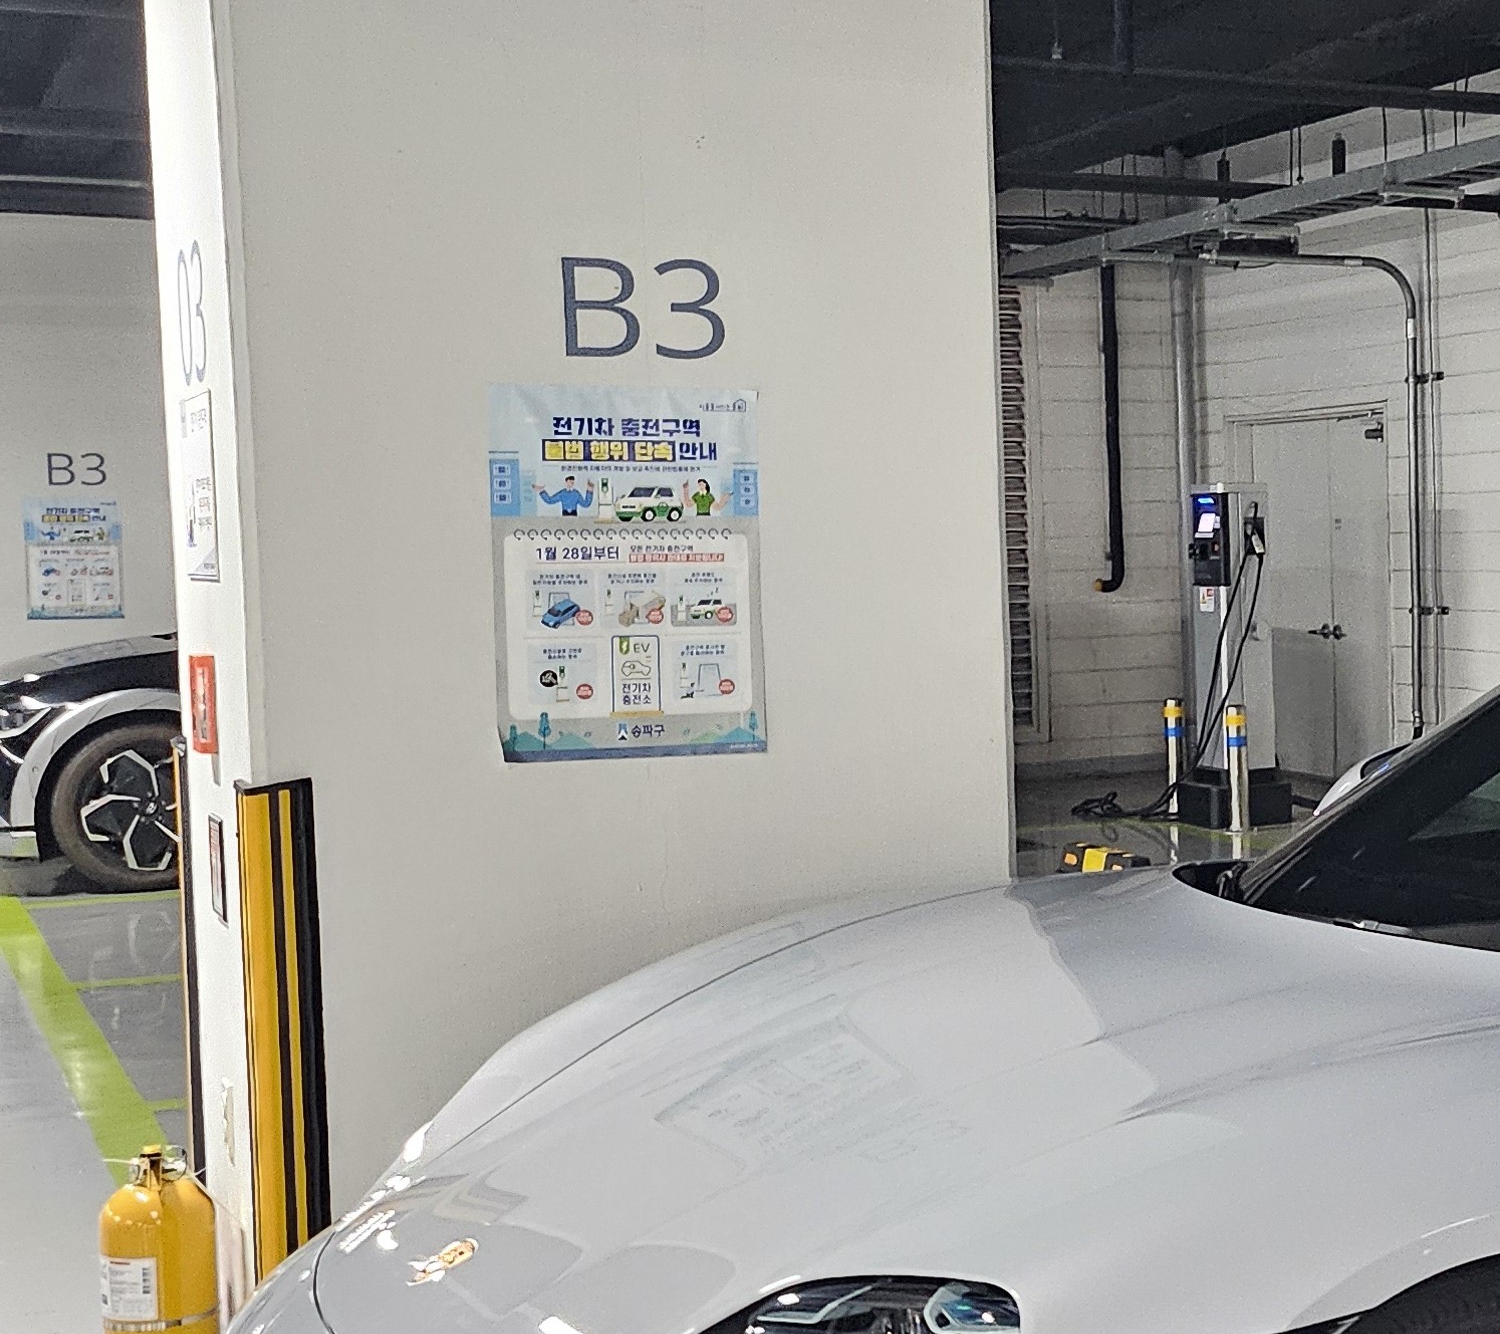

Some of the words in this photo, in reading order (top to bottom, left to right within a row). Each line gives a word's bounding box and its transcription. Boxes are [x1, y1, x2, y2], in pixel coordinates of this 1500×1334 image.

[561, 256, 726, 359] B3
[553, 416, 614, 437] 전기차
[621, 417, 701, 437] 충전구역
[590, 441, 629, 461] 행위
[634, 442, 674, 461] 단속
[679, 441, 717, 461] 안내
[47, 453, 107, 486] B3
[536, 547, 557, 561] 1월
[562, 547, 620, 561] 28일부터
[633, 643, 651, 654] EV
[622, 682, 652, 694] 전기차
[622, 694, 652, 706] 충전소
[631, 724, 666, 740] 송파구
